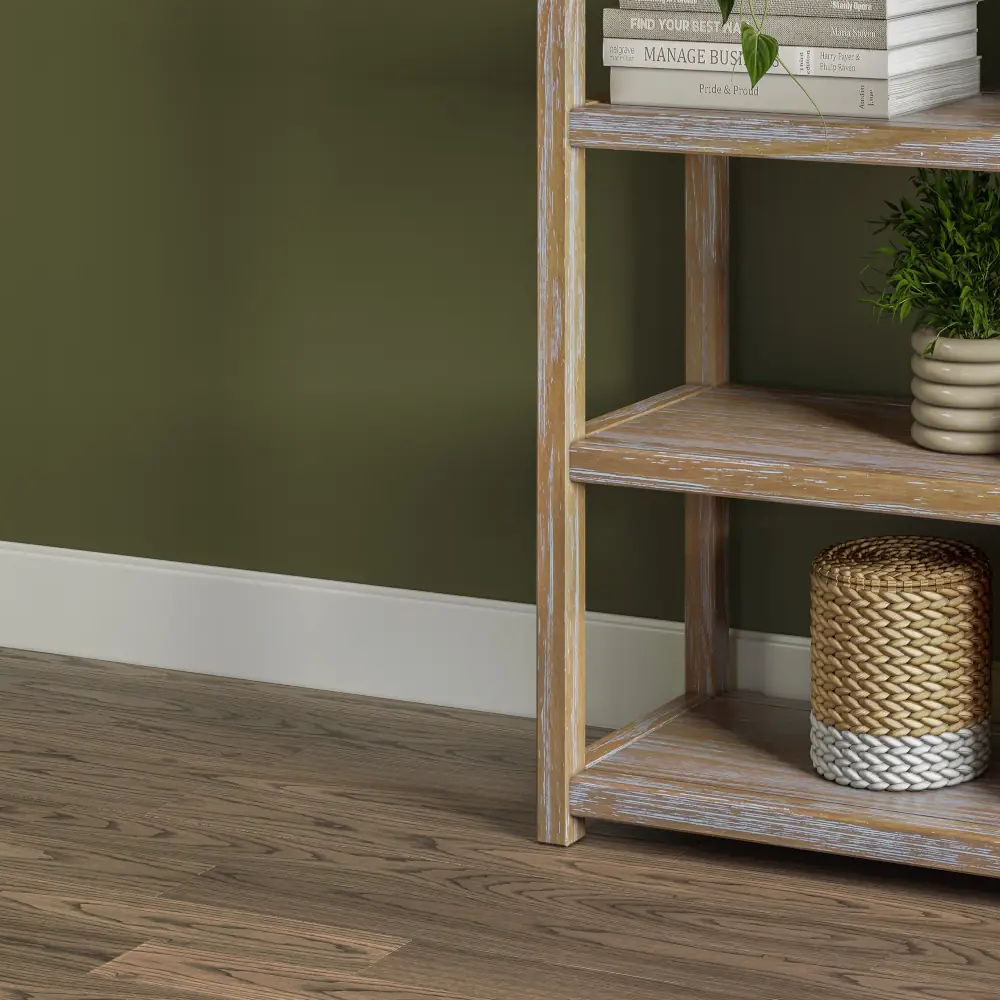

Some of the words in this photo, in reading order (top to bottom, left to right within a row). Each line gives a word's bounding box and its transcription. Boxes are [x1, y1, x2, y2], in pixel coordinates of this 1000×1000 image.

[630, 18, 656, 31] FIND
[658, 19, 690, 32] YOUR
[691, 21, 720, 34] BEST
[644, 46, 706, 64] MANAGE
[710, 49, 779, 67] BUSIS
[700, 84, 722, 94] Pride
[723, 86, 731, 95] &
[733, 85, 759, 96] Proud
